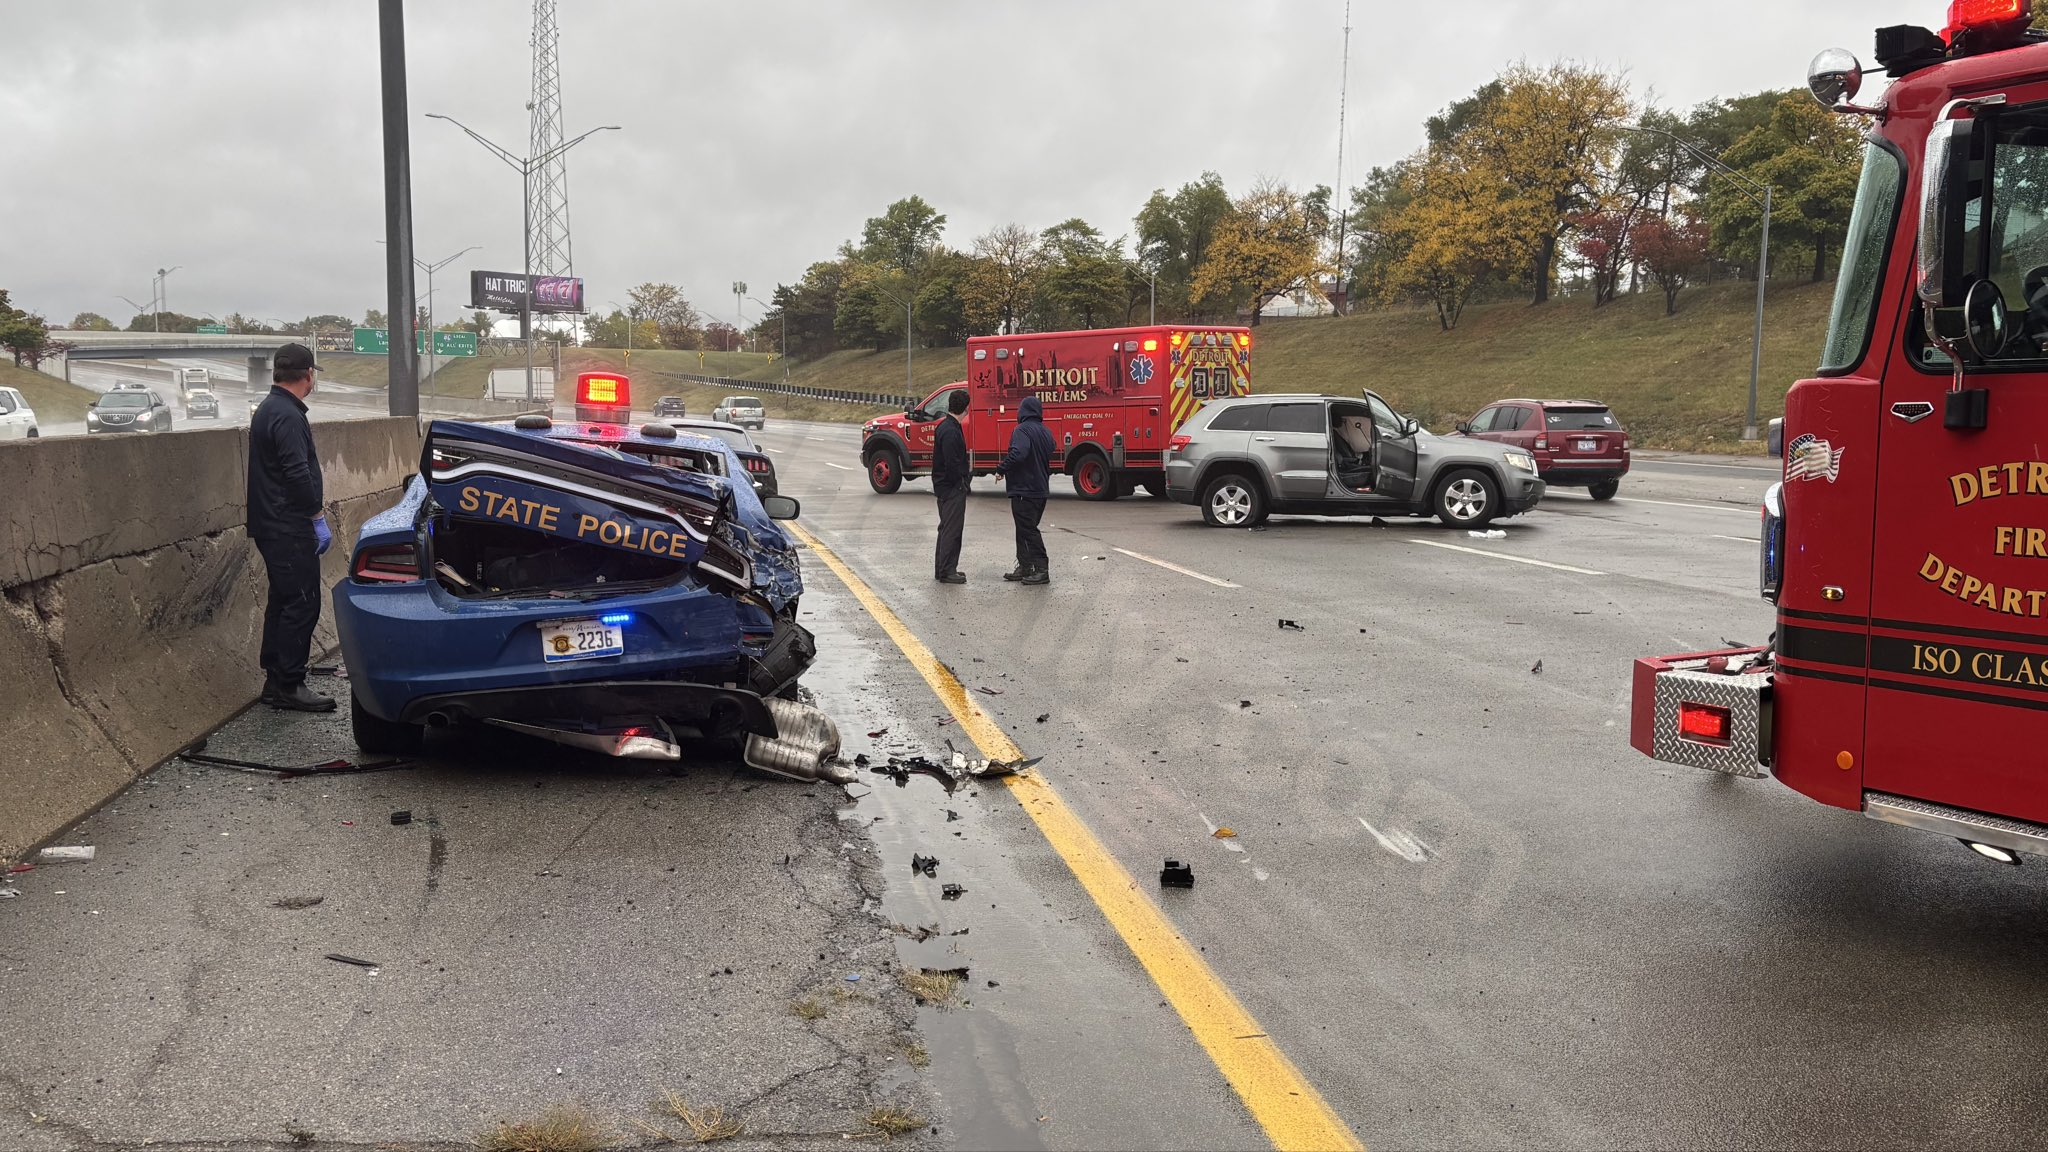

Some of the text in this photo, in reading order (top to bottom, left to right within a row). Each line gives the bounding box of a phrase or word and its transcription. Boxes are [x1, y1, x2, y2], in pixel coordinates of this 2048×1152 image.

[485, 277, 533, 294] HAT TRIC.
[1192, 350, 1229, 363] DETROIT
[1022, 366, 1099, 388] DETROIT
[1034, 390, 1088, 403] FIRE/EMS
[459, 486, 688, 558] STATE POLICE
[577, 630, 614, 651] 2236
[1912, 644, 1961, 674] ISO
